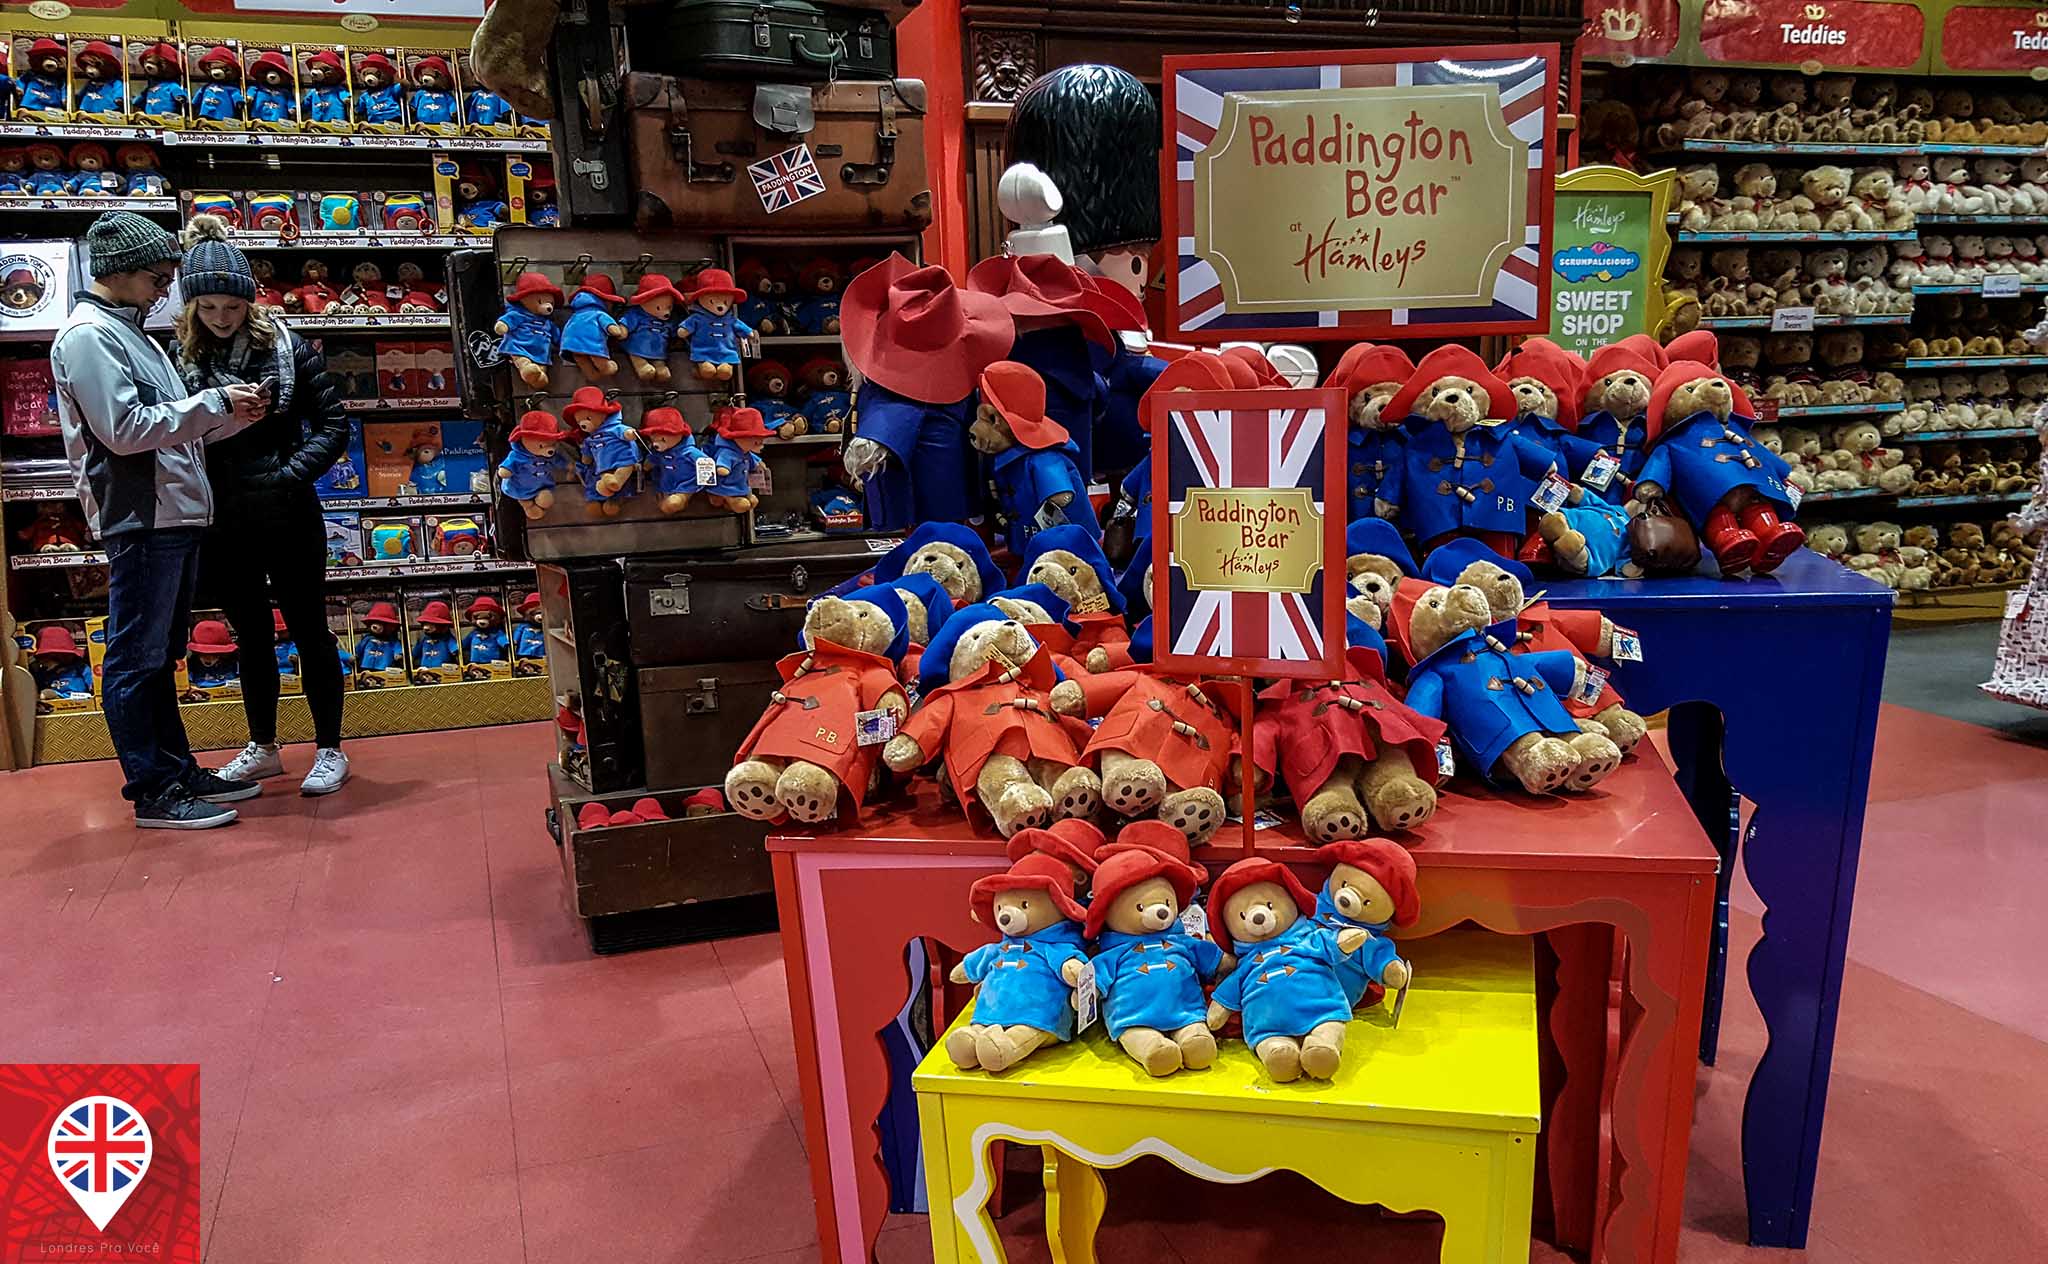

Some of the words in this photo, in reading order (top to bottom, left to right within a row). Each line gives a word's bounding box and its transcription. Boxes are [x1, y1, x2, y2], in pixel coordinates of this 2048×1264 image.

[1781, 23, 1847, 45] Teddies
[2012, 30, 2048, 50] Tedd
[217, 135, 236, 143] Bear
[362, 137, 398, 147] Paddington
[450, 139, 485, 149] Paddington
[1248, 111, 1473, 183] Paddington
[761, 166, 812, 193] PADDINGTON
[108, 200, 126, 208] Bear
[1346, 170, 1448, 219] Bear
[1572, 200, 1625, 234] Hamleys
[1290, 221, 1302, 233] at
[0, 256, 44, 269] ADDINGTON
[1294, 219, 1426, 288] Hamleys
[1555, 290, 1632, 313] SWEET
[1561, 314, 1624, 336] SHOP
[1575, 338, 1588, 346] ON
[46, 488, 65, 497] Bear
[1198, 498, 1301, 533] Paddington
[1241, 525, 1289, 549] Bear
[53, 556, 72, 565] Bear
[446, 564, 464, 572] Bear
[1219, 547, 1280, 582] Hamleys
[361, 569, 378, 577] Bear
[815, 727, 837, 745] P.B.
